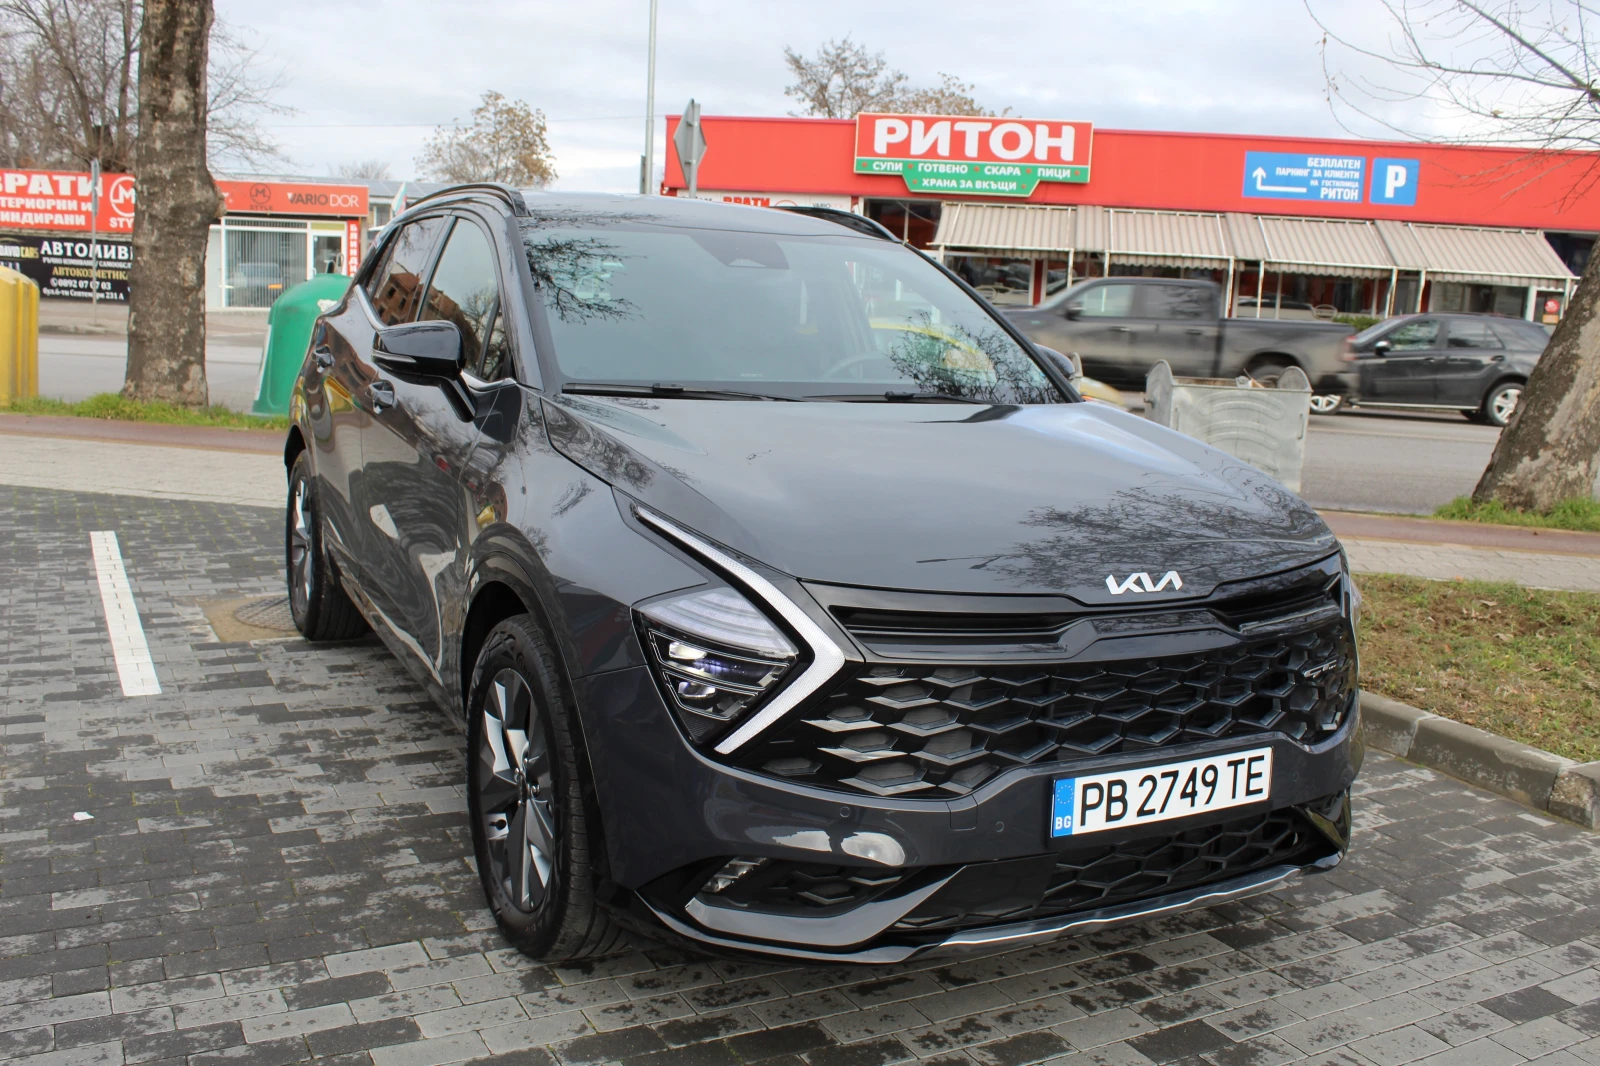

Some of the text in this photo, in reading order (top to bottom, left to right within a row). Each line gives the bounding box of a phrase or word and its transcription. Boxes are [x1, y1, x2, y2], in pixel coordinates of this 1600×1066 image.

[873, 118, 1076, 162] РИТОН
[872, 161, 1071, 179] СУПИ ГОТВЕНО СКАРА ПИЦИ
[1307, 157, 1361, 170] БЕЗПЛАТЕН
[1312, 168, 1322, 178] ЗА
[1384, 165, 1407, 199] P
[0, 173, 103, 198] РАТИ
[922, 178, 1017, 191] ХРАНА ЗА ВКЪЩИ
[1320, 187, 1359, 201] РИТОН
[1106, 571, 1183, 595] KIA
[1080, 755, 1265, 827] PB 2749 TE
[1055, 815, 1072, 830] BG
